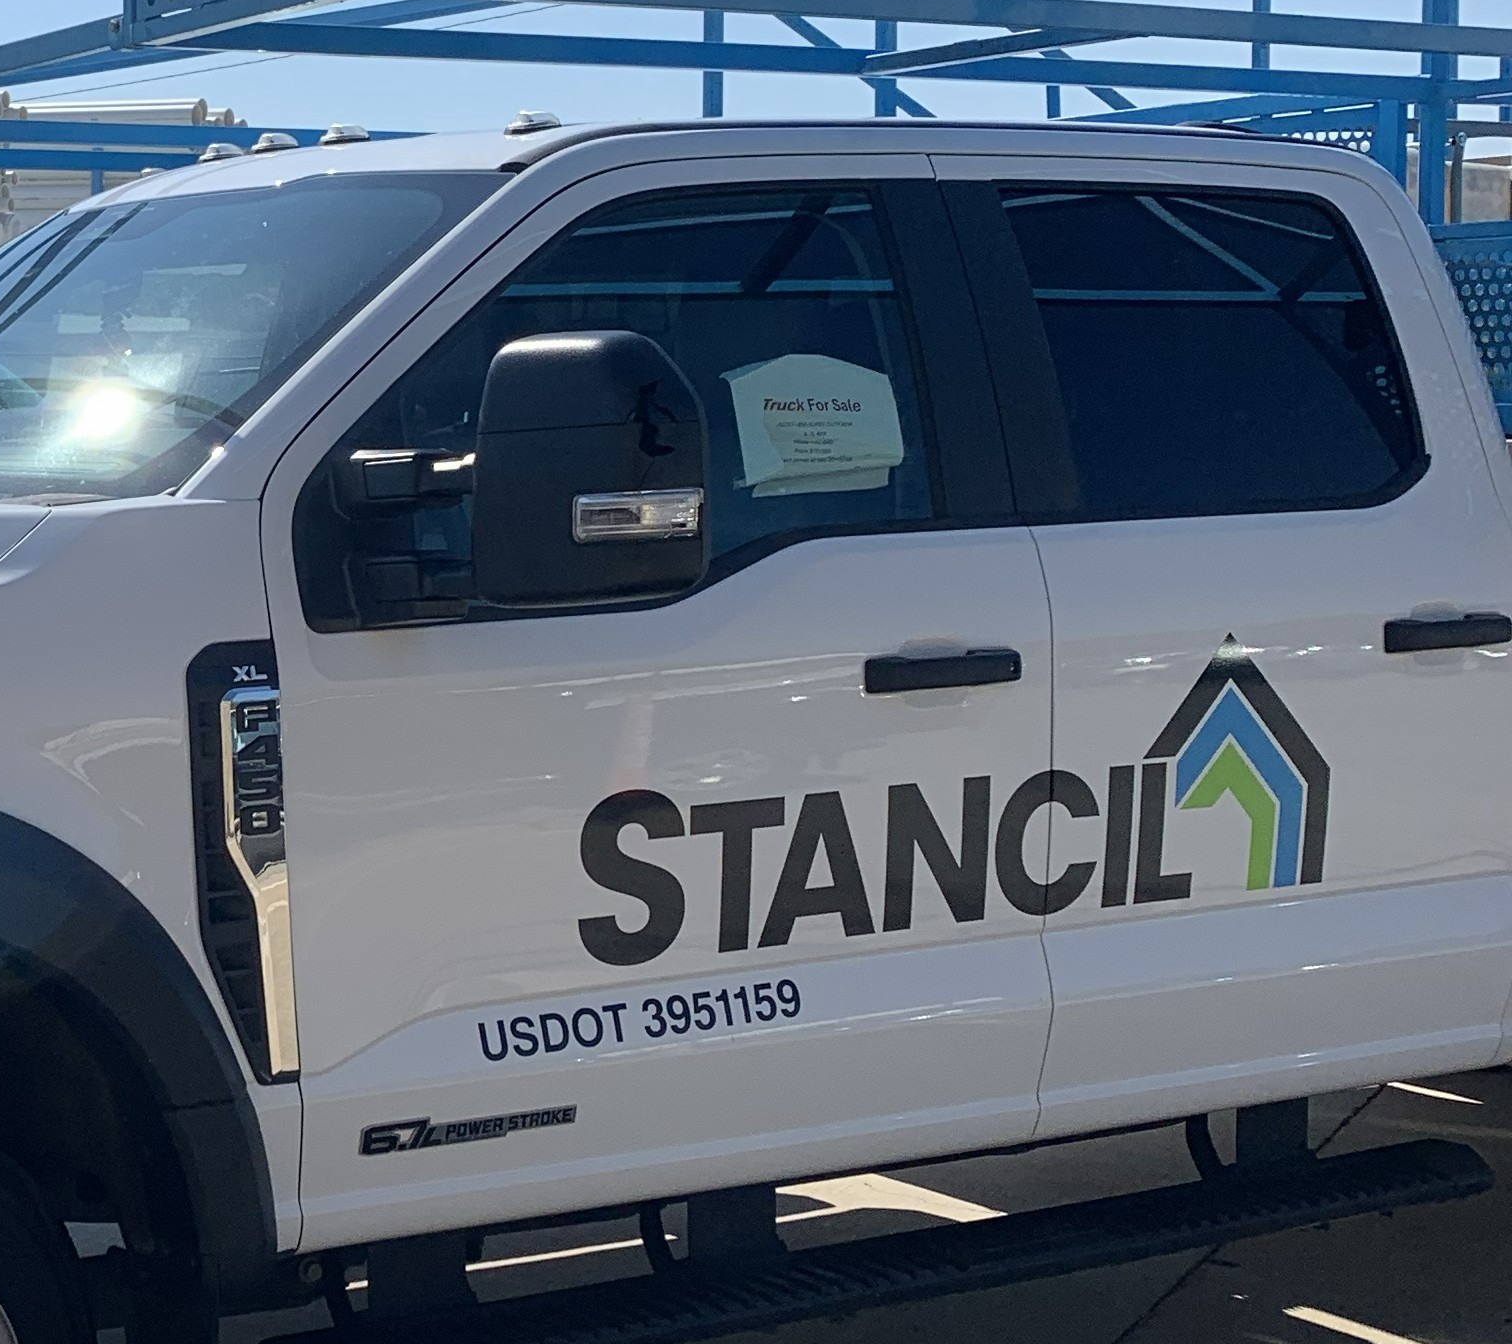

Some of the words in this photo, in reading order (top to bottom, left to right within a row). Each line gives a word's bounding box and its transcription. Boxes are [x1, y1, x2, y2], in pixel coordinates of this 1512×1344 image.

[763, 398, 804, 412] Truck
[807, 398, 829, 412] For
[832, 398, 861, 413] Sale
[232, 664, 269, 683] XL
[577, 761, 1193, 966] STANCIL
[477, 1002, 627, 1062] USDOT
[641, 978, 802, 1039] 3951159
[360, 1119, 442, 1156] 6.7L
[444, 1116, 505, 1142] POWER
[507, 1106, 575, 1131] STROKE
